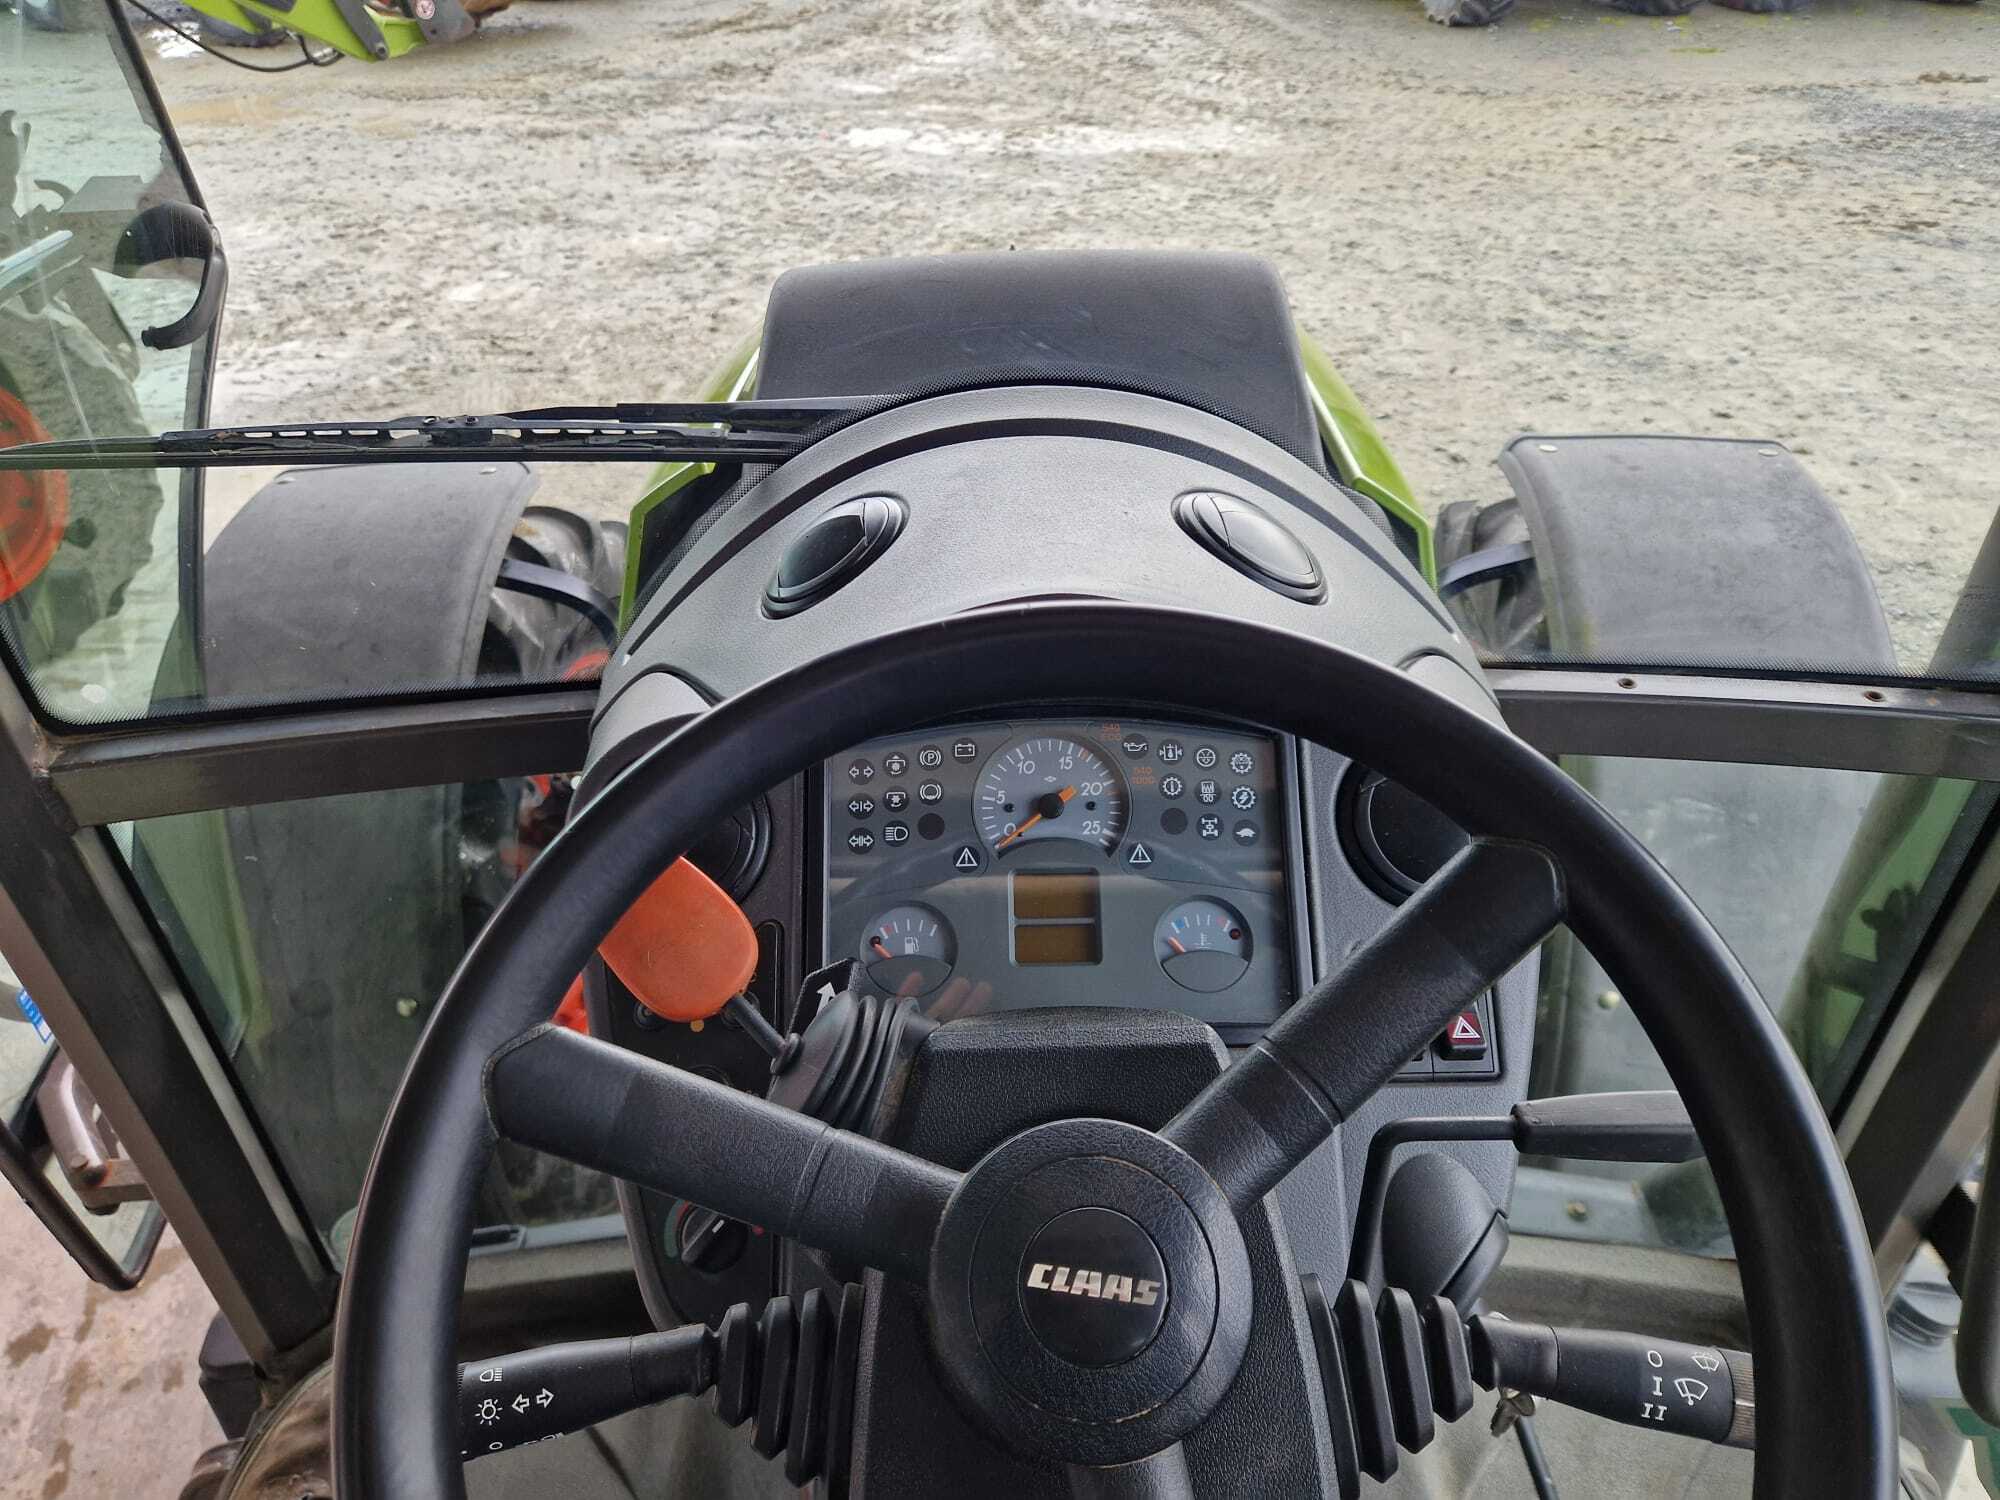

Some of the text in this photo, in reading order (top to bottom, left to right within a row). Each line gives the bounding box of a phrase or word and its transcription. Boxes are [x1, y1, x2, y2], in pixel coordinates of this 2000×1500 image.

[1018, 760, 1036, 775] 10
[1059, 756, 1073, 770] 15
[1081, 782, 1103, 796] 20
[996, 791, 1006, 804] 5
[1004, 823, 1017, 837] 0
[1082, 821, 1101, 835] 25
[1027, 1263, 1161, 1306] CLAAS
[1641, 1402, 1668, 1421] II
